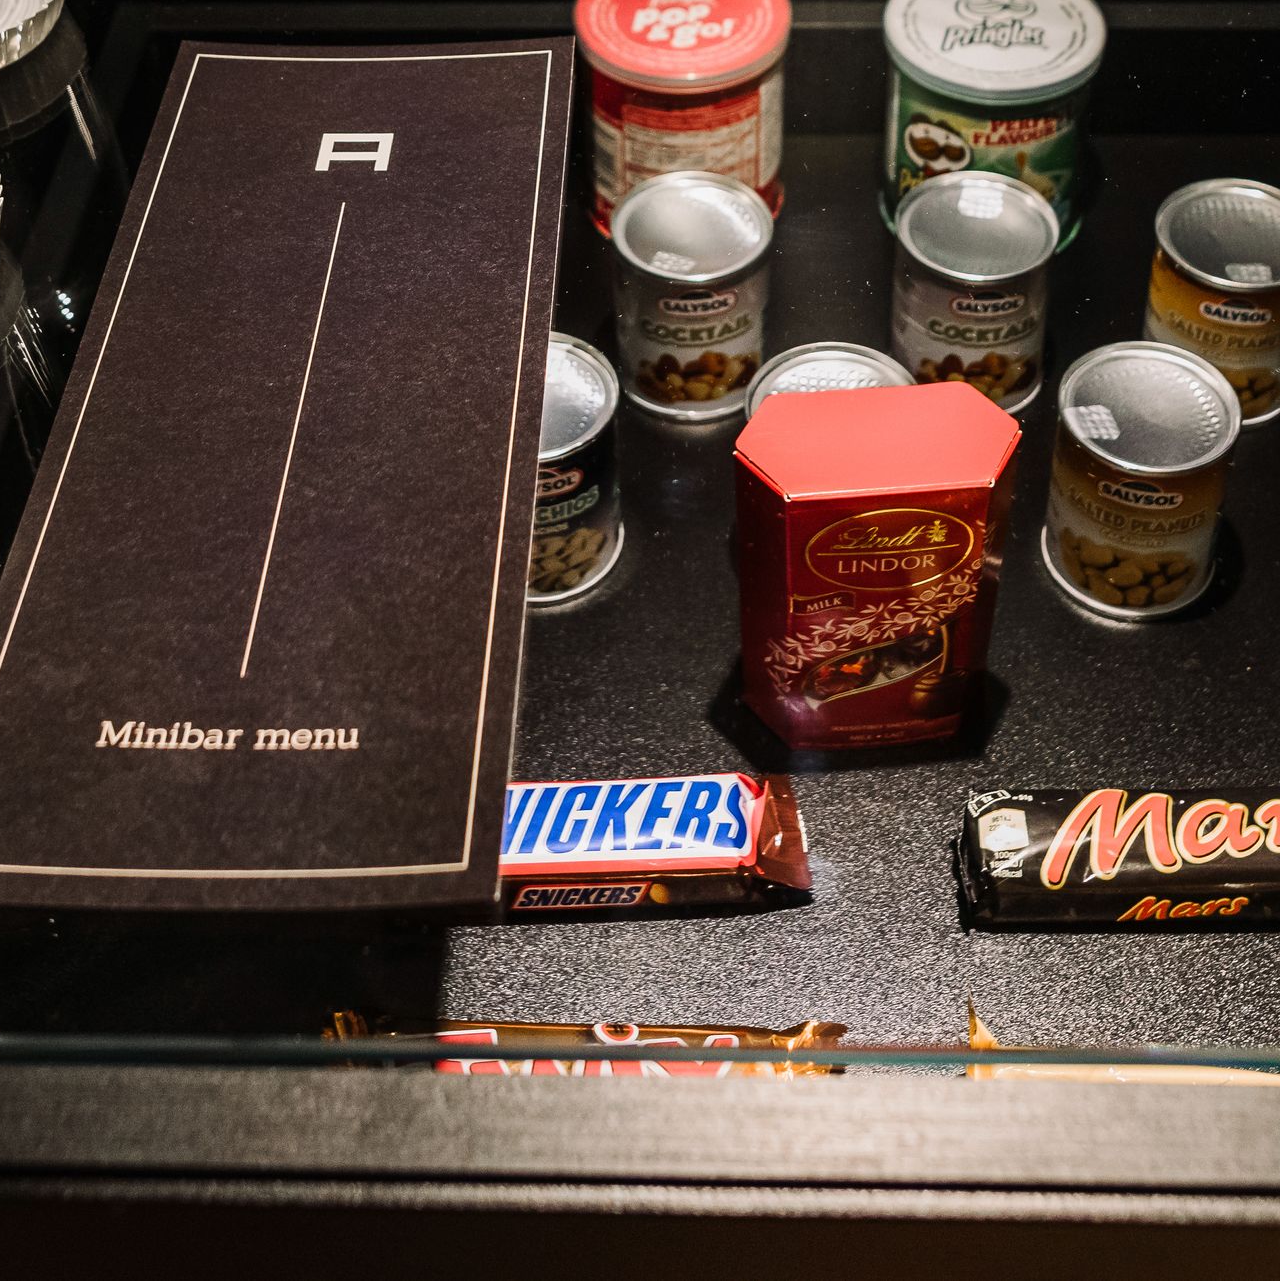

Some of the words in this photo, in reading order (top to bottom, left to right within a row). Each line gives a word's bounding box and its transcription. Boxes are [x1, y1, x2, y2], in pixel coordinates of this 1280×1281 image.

[631, 3, 711, 33] pop
[941, 18, 1046, 52] Pringles
[662, 297, 730, 313] SALYSOL
[955, 298, 1021, 313] SALYSOL
[1203, 303, 1268, 322] SALYSOL
[535, 485, 599, 521] CHIOS
[1101, 482, 1180, 506] SALYSOL
[833, 525, 926, 550] Lindt
[837, 553, 937, 574] LINDOR
[806, 596, 843, 613] MILK
[95, 720, 244, 750] Minibar
[253, 727, 360, 750] menu
[500, 780, 748, 856] NICKERS
[520, 885, 643, 907] SNICKERS
[1117, 896, 1249, 922] Mars
